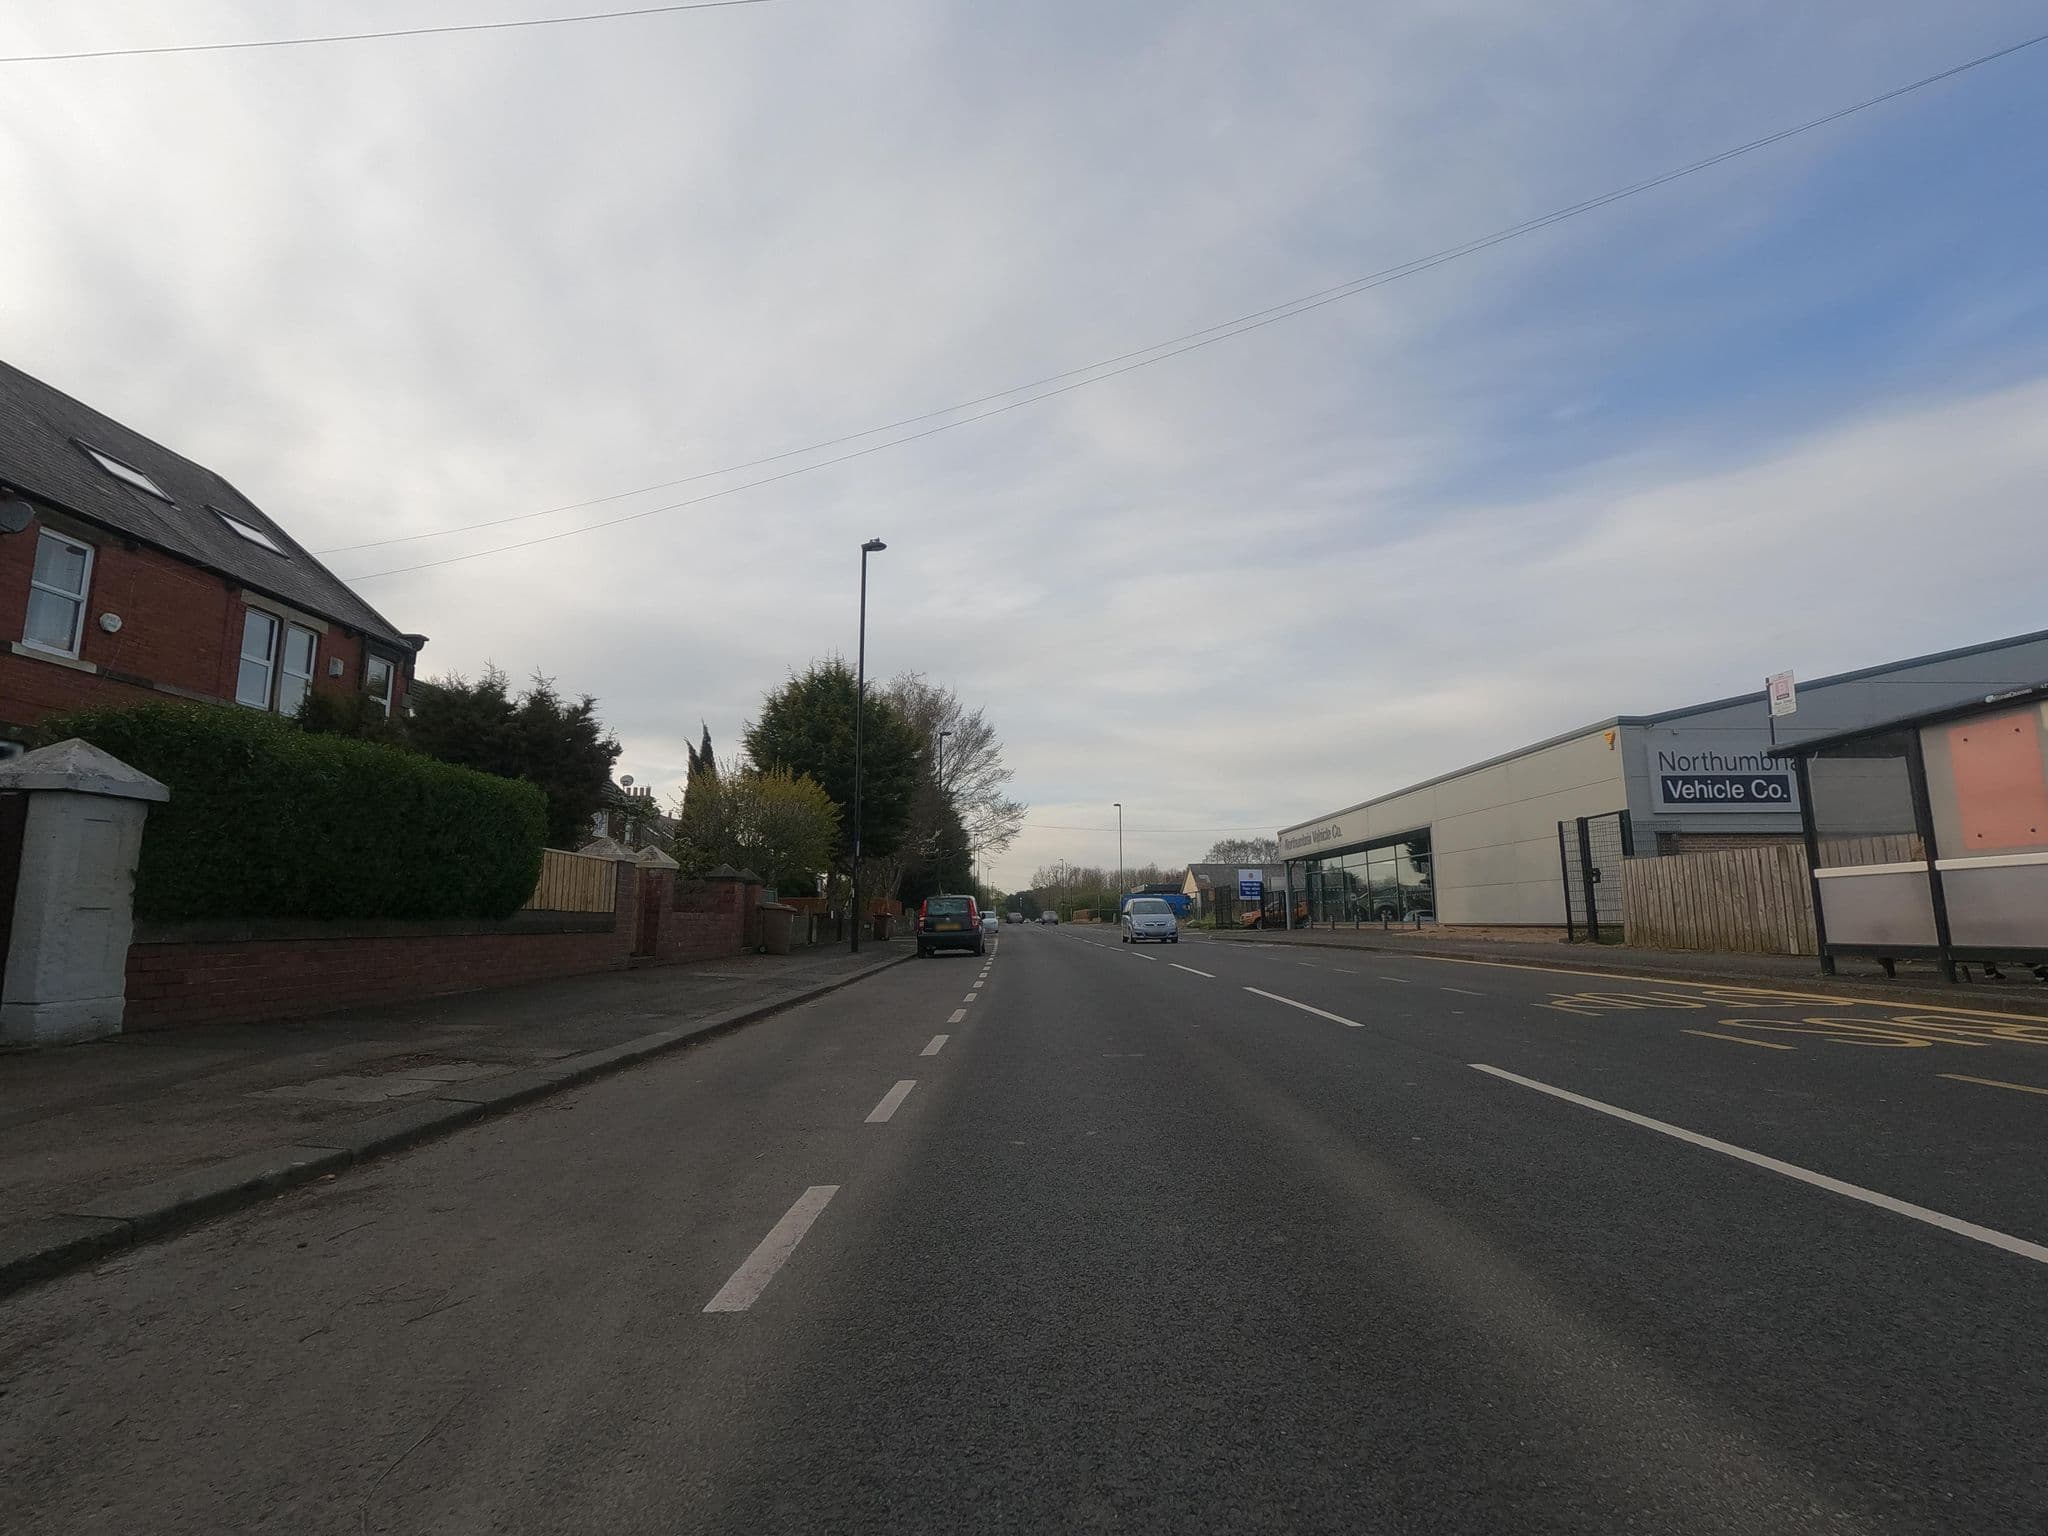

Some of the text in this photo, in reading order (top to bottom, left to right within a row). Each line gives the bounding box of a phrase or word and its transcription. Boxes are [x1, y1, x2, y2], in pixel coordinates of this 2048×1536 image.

[1666, 779, 1788, 799] Vehicle Co.
[1546, 990, 1855, 1010] STOP
